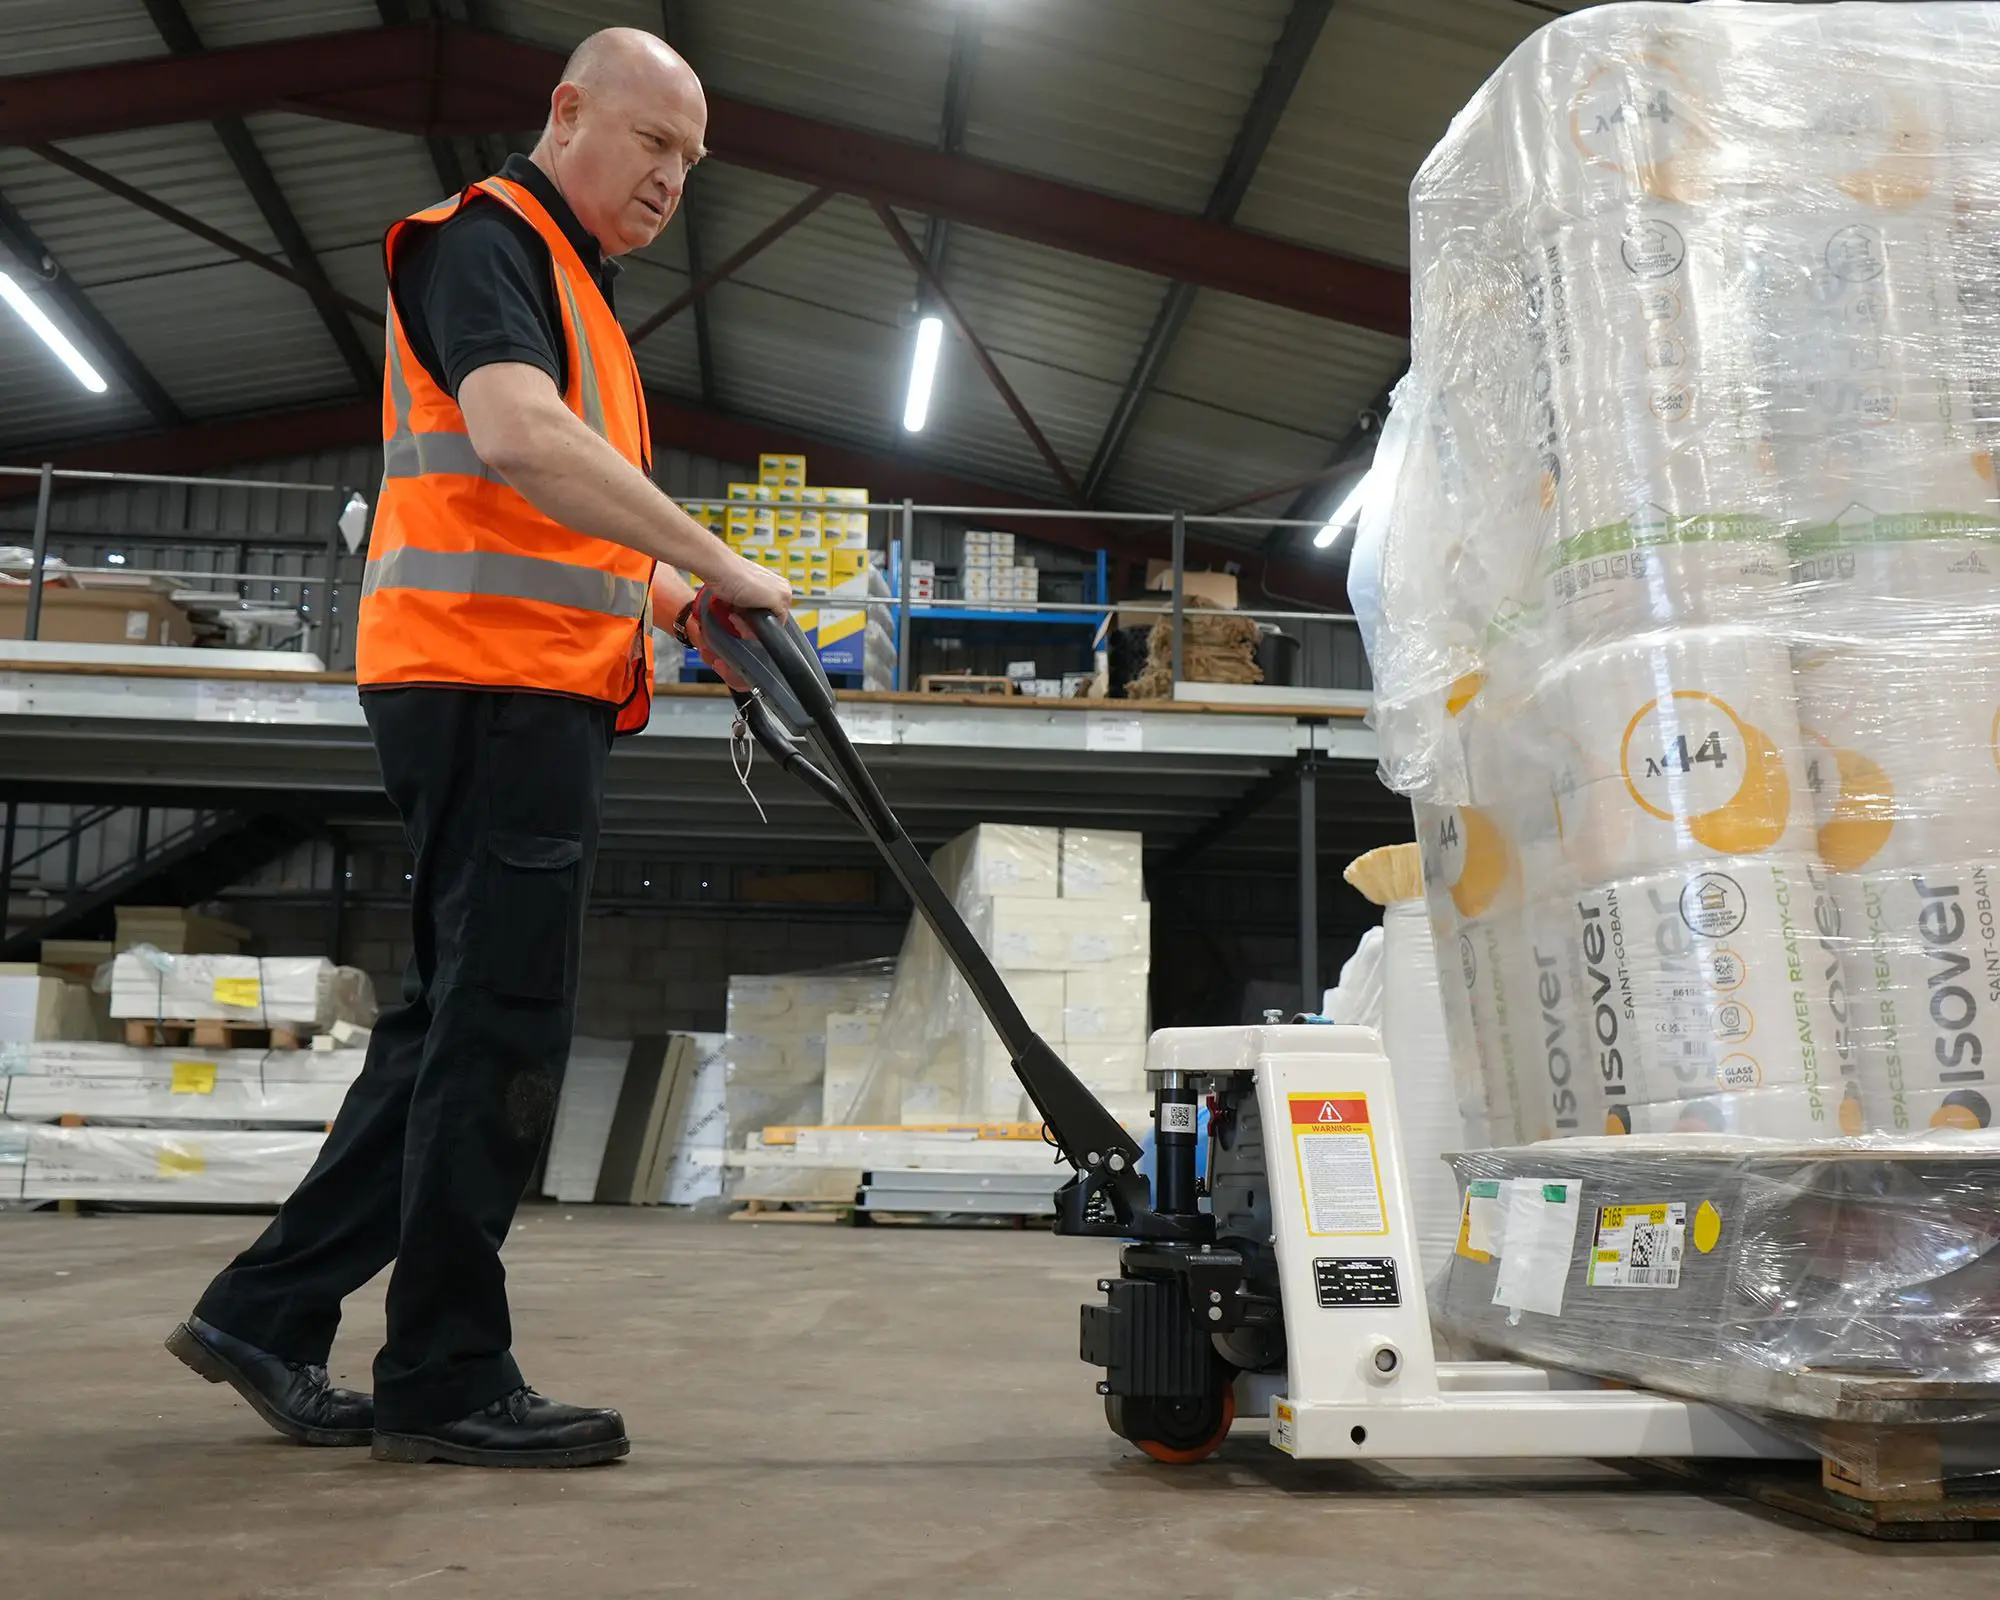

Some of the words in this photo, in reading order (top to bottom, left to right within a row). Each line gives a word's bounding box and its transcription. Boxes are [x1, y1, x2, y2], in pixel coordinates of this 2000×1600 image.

[1606, 888, 1635, 1020] SAINT-GOBAIN
[1771, 866, 1804, 983] READY-CUT
[1972, 864, 2000, 1003] SAINT-GOBAIN
[1724, 1066, 1754, 1076] GLASS
[1726, 1075, 1754, 1084] WOOL
[1793, 990, 1825, 1122] SPACESAVER
[1311, 1124, 1353, 1132] WARNING
[1602, 1207, 1622, 1227] F165
